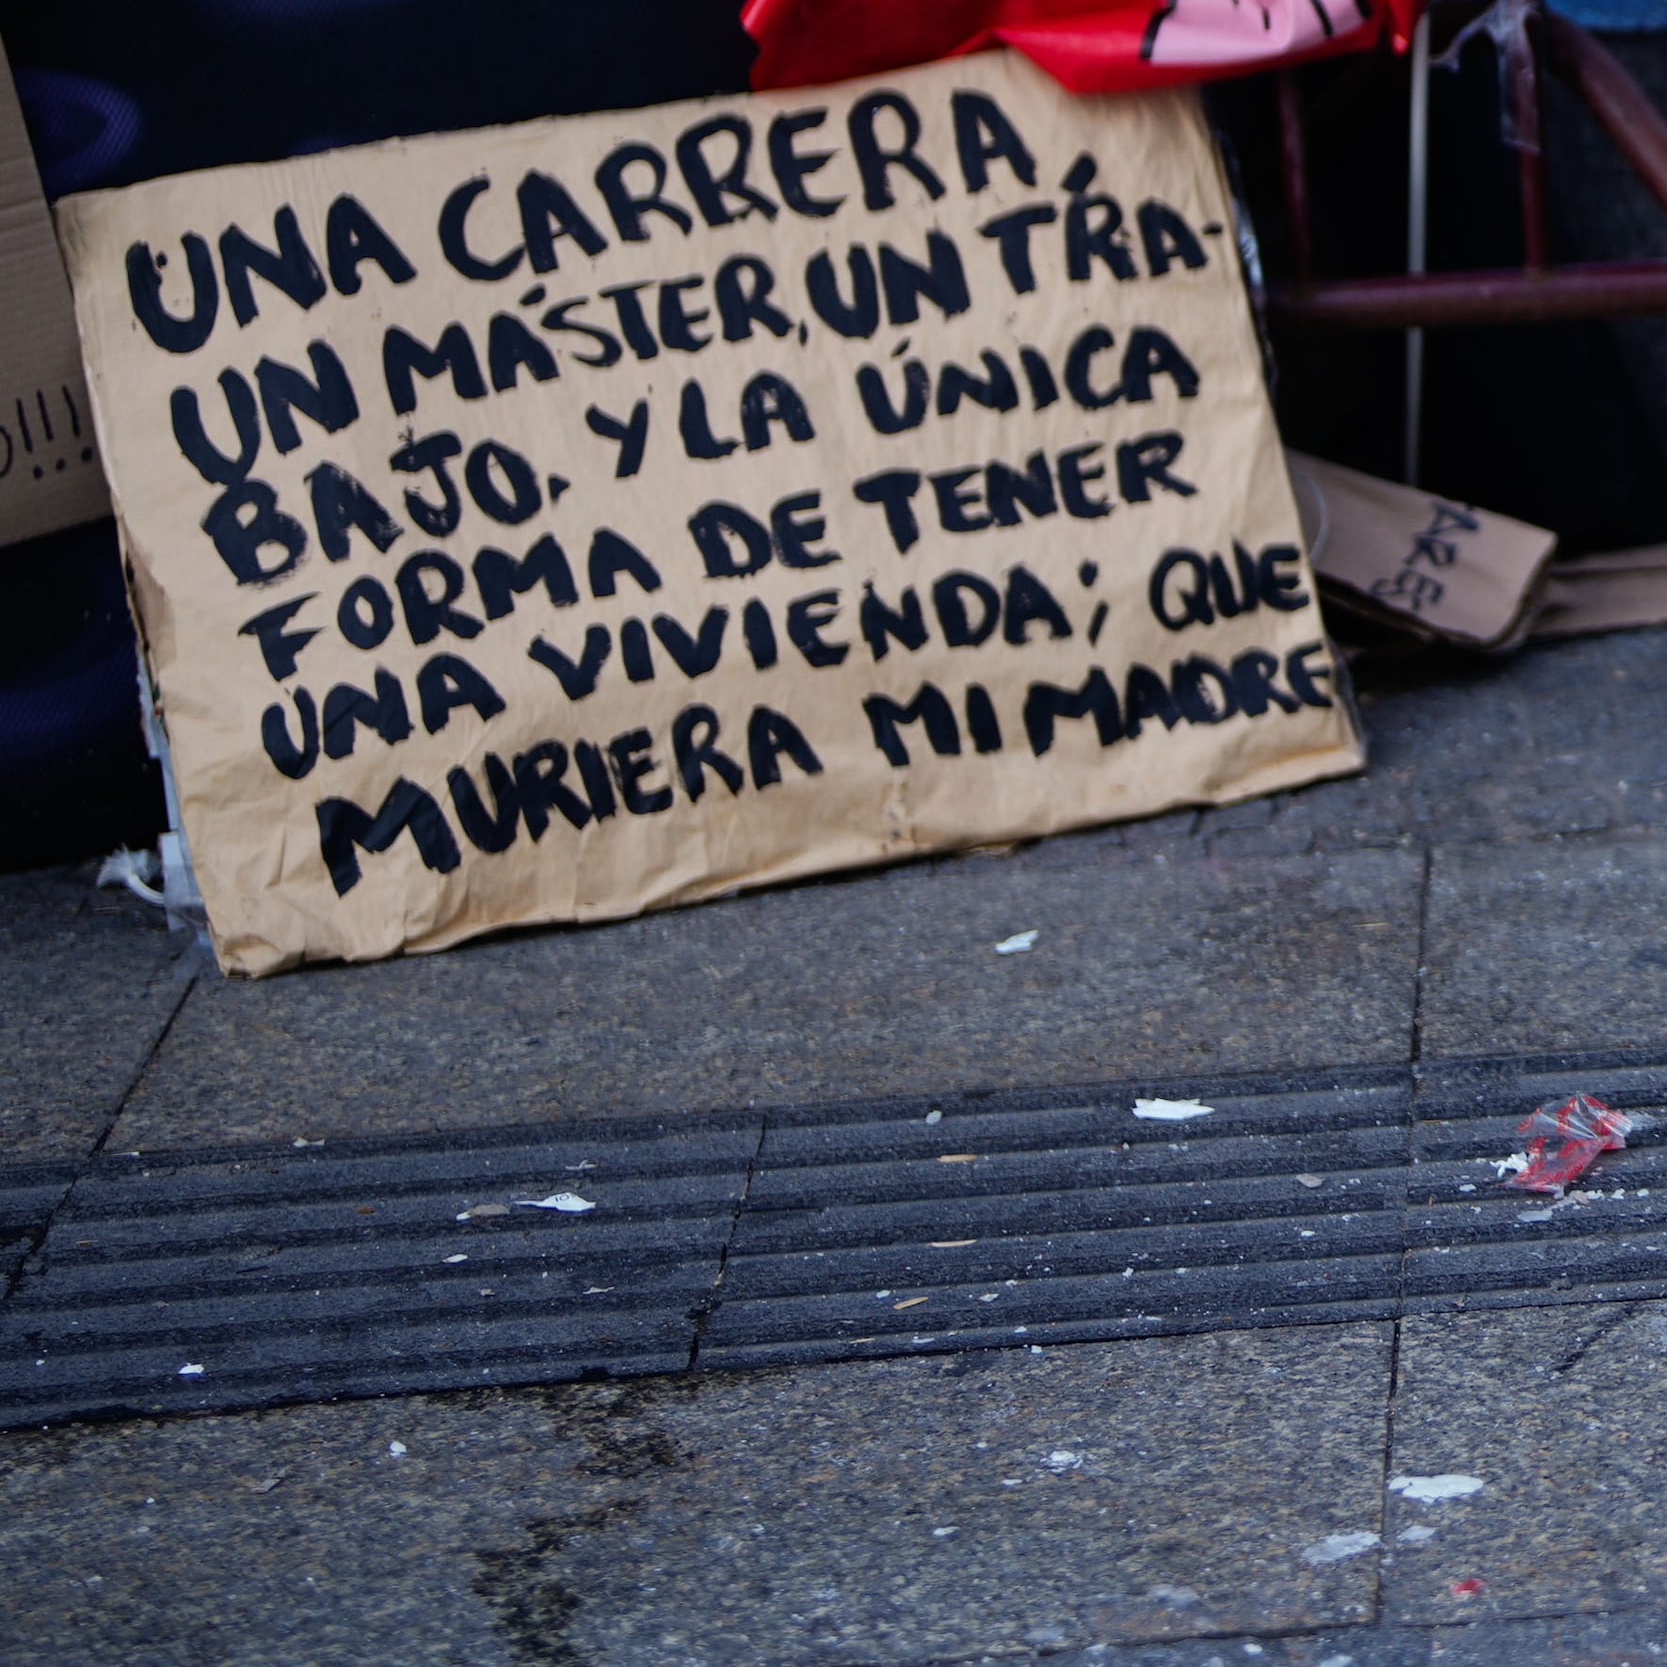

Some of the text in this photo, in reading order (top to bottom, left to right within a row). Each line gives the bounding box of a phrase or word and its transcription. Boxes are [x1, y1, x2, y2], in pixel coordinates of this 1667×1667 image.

[126, 195, 416, 353] UNA
[169, 341, 360, 485] UN
[806, 227, 974, 340] UN
[584, 399, 652, 480] Y
[675, 369, 819, 463] LA
[855, 322, 1202, 439] ÚNICA
[238, 426, 1201, 683] FORMA DE TENER
[260, 650, 506, 783] UNA
[1148, 538, 1311, 633] QUE
[313, 639, 1338, 898] MURIERA MI MADRE
